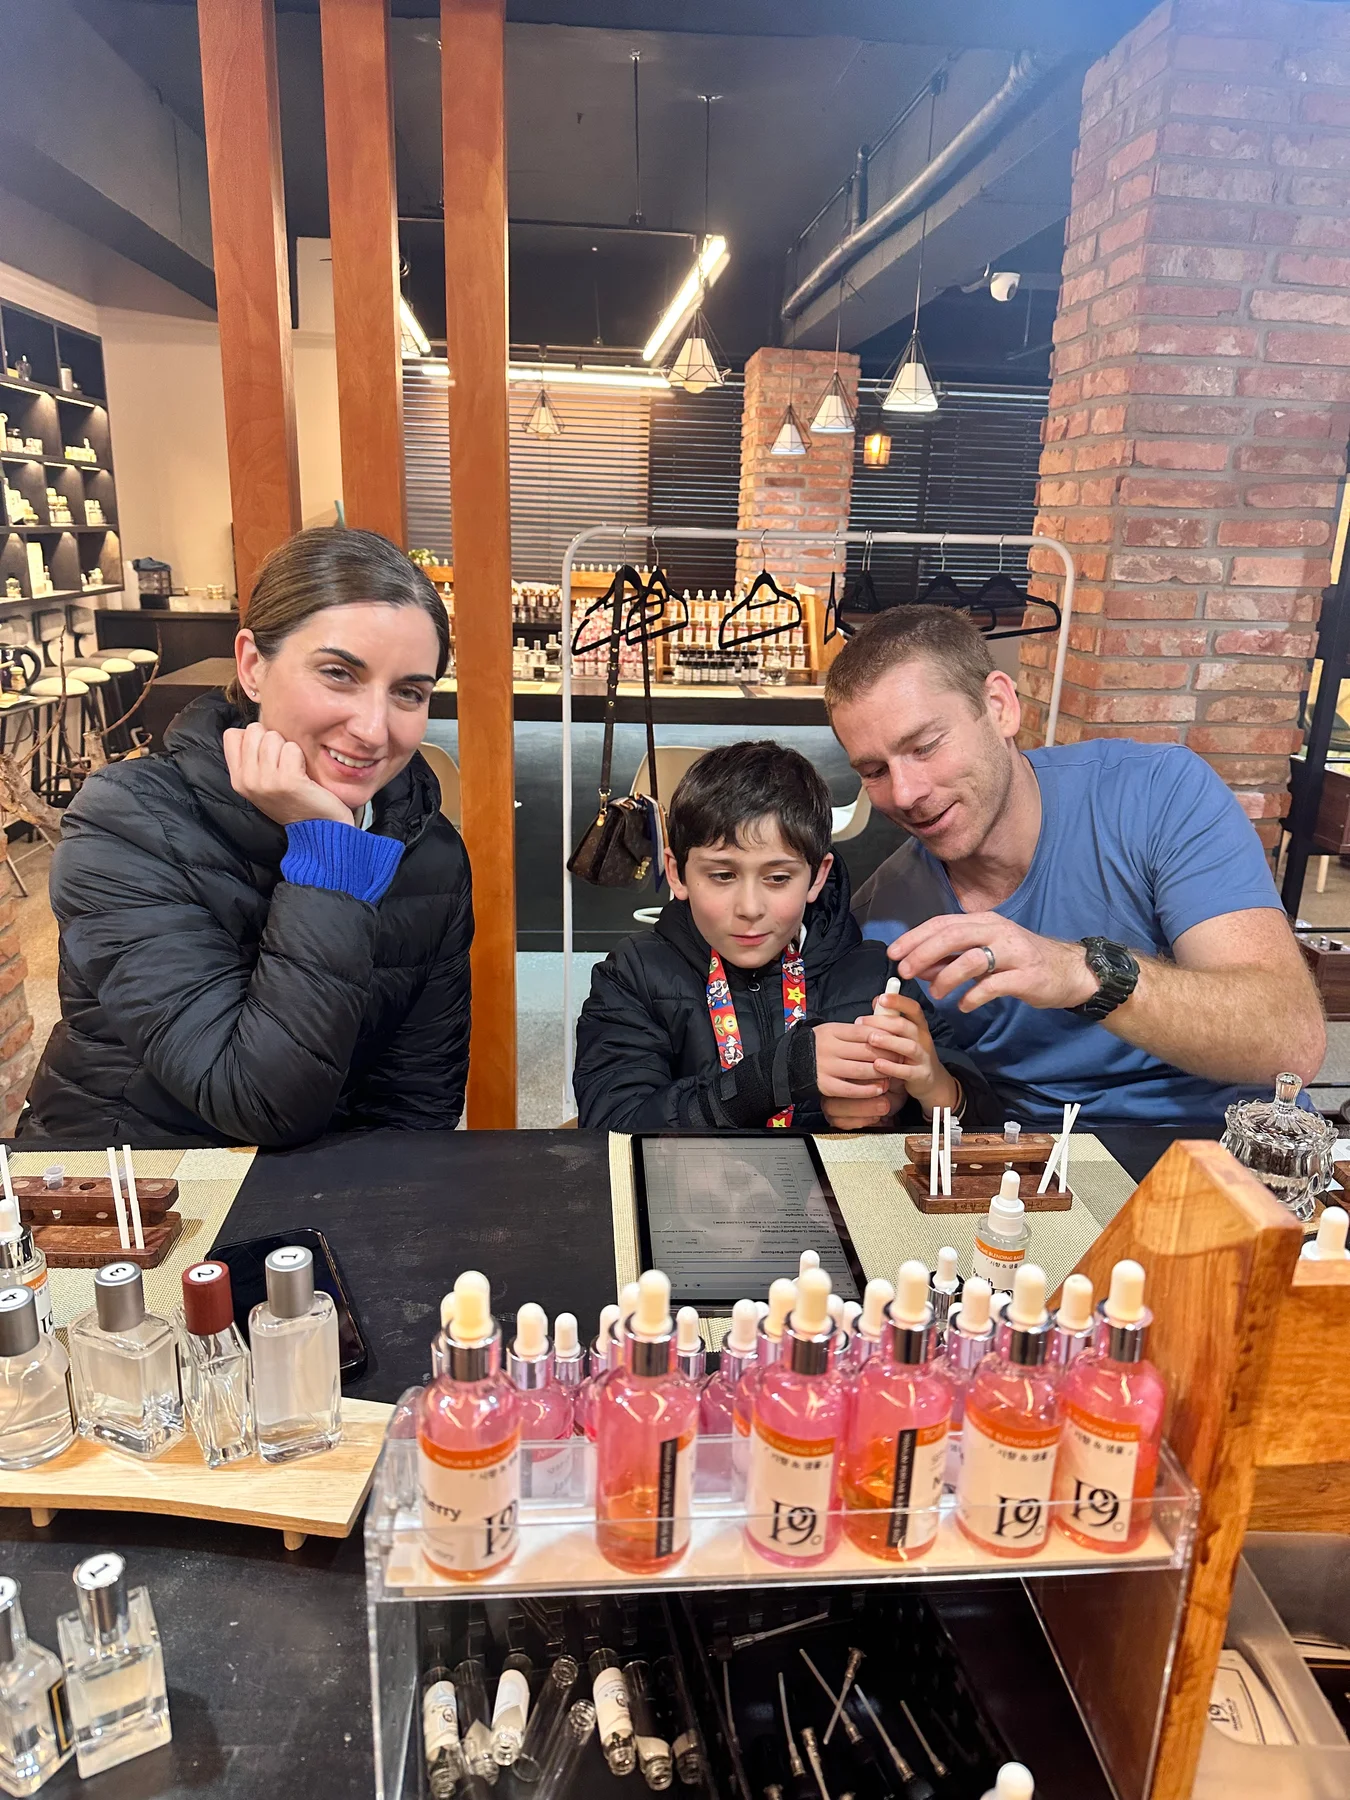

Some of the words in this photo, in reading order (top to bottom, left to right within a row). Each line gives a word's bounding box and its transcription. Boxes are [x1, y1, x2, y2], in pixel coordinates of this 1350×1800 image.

[281, 1252, 298, 1261] 1
[109, 1266, 126, 1277] 3
[197, 1268, 214, 1279] 2
